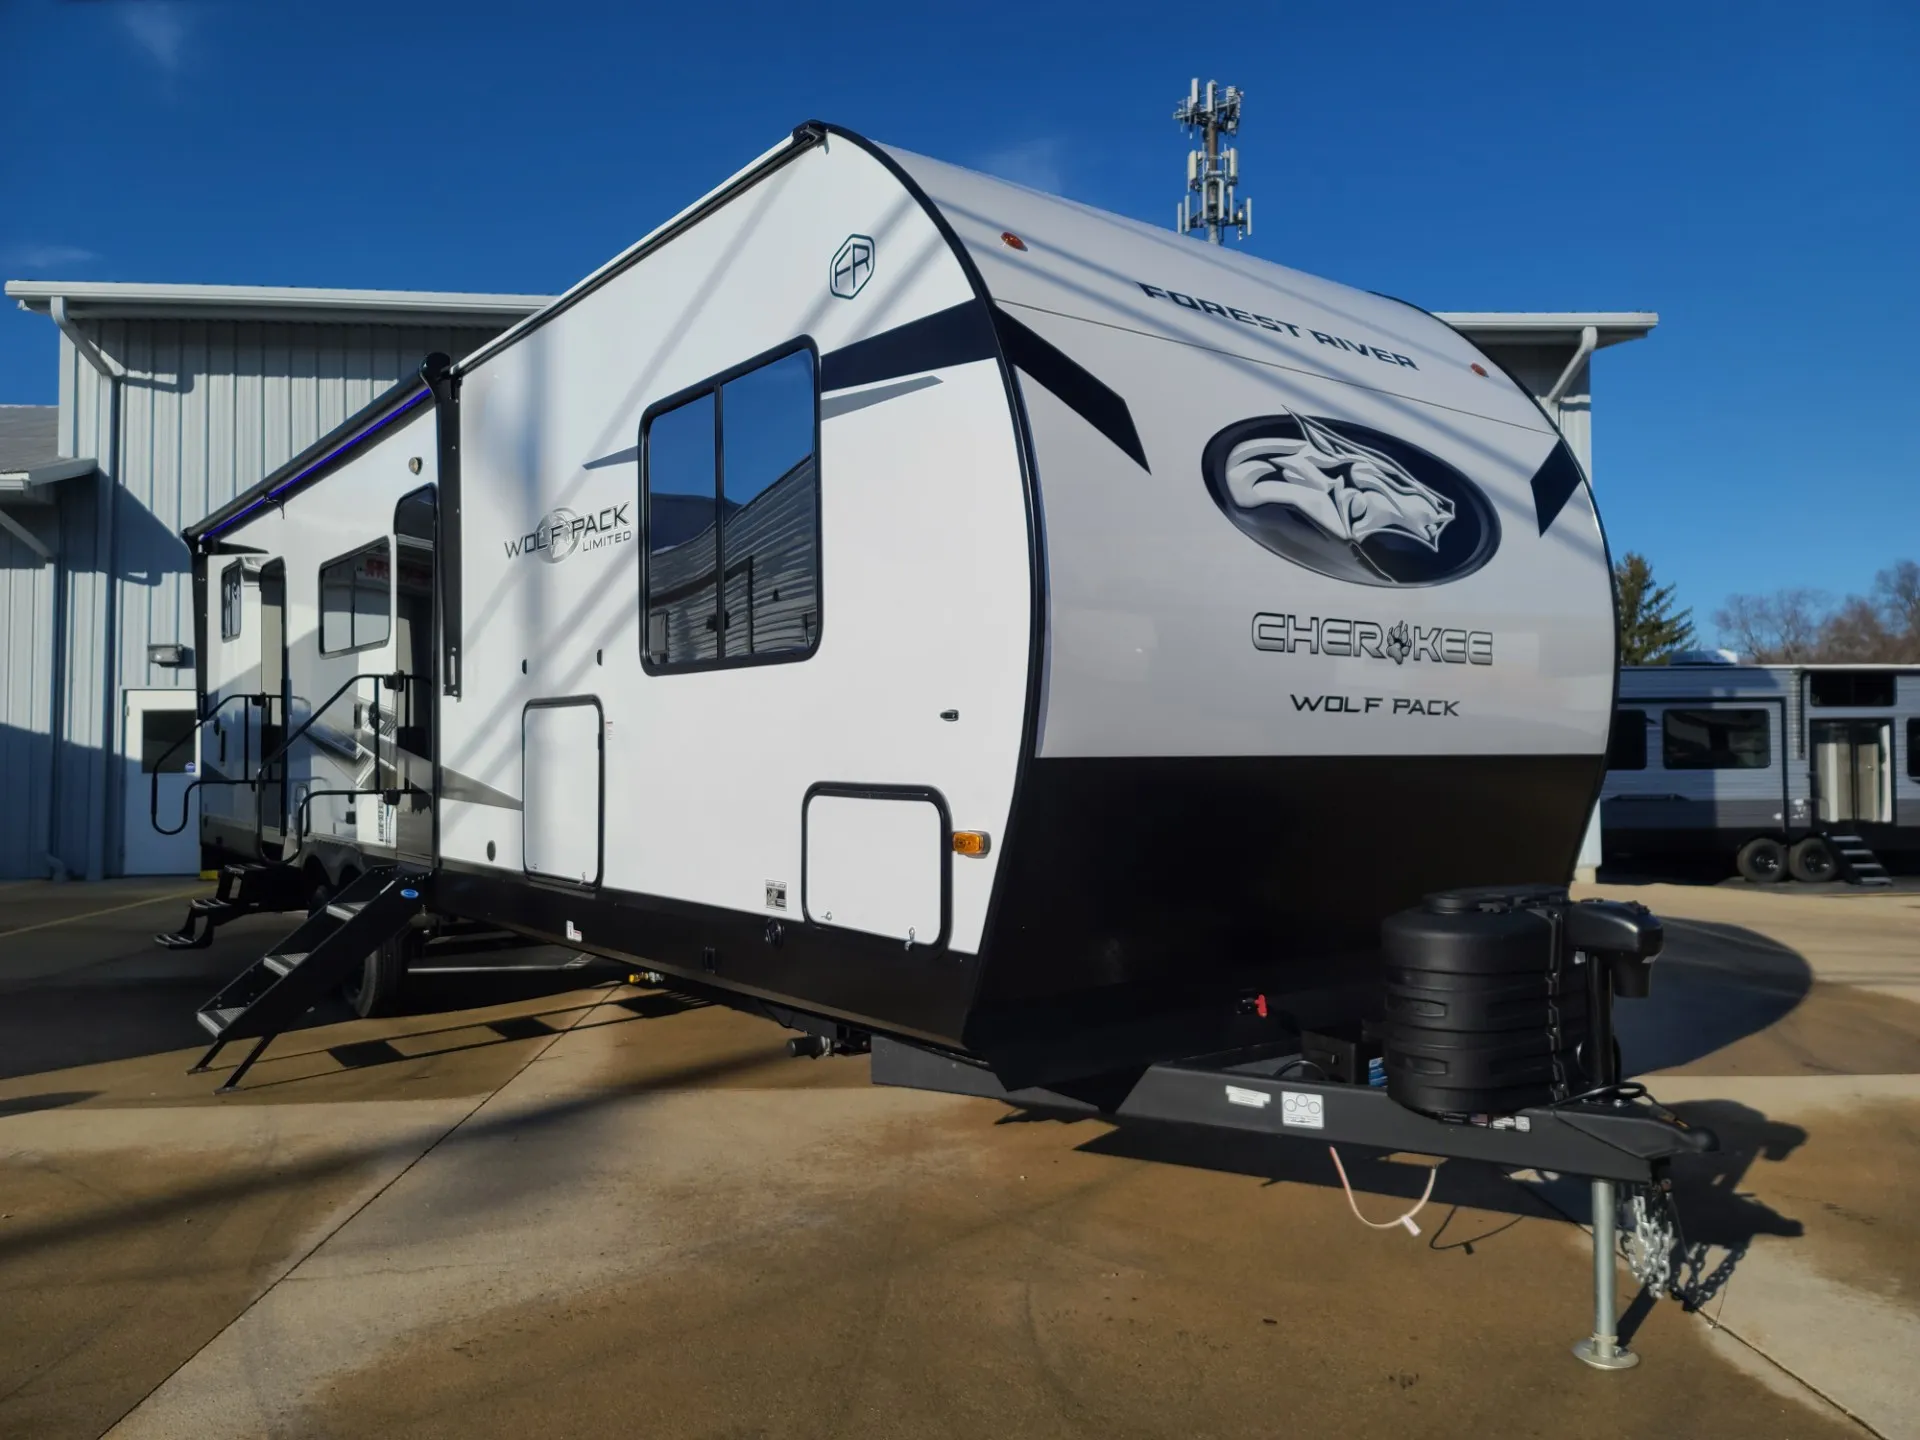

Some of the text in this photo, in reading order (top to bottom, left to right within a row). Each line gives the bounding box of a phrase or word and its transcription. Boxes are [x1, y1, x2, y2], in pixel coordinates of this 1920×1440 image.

[1135, 281, 1420, 371] FOREST RIVER
[504, 501, 632, 560] WOLF PACK
[583, 530, 632, 551] LIMITED
[1251, 611, 1493, 666] CHEROKEE
[1290, 694, 1460, 717] WOLF PACK
